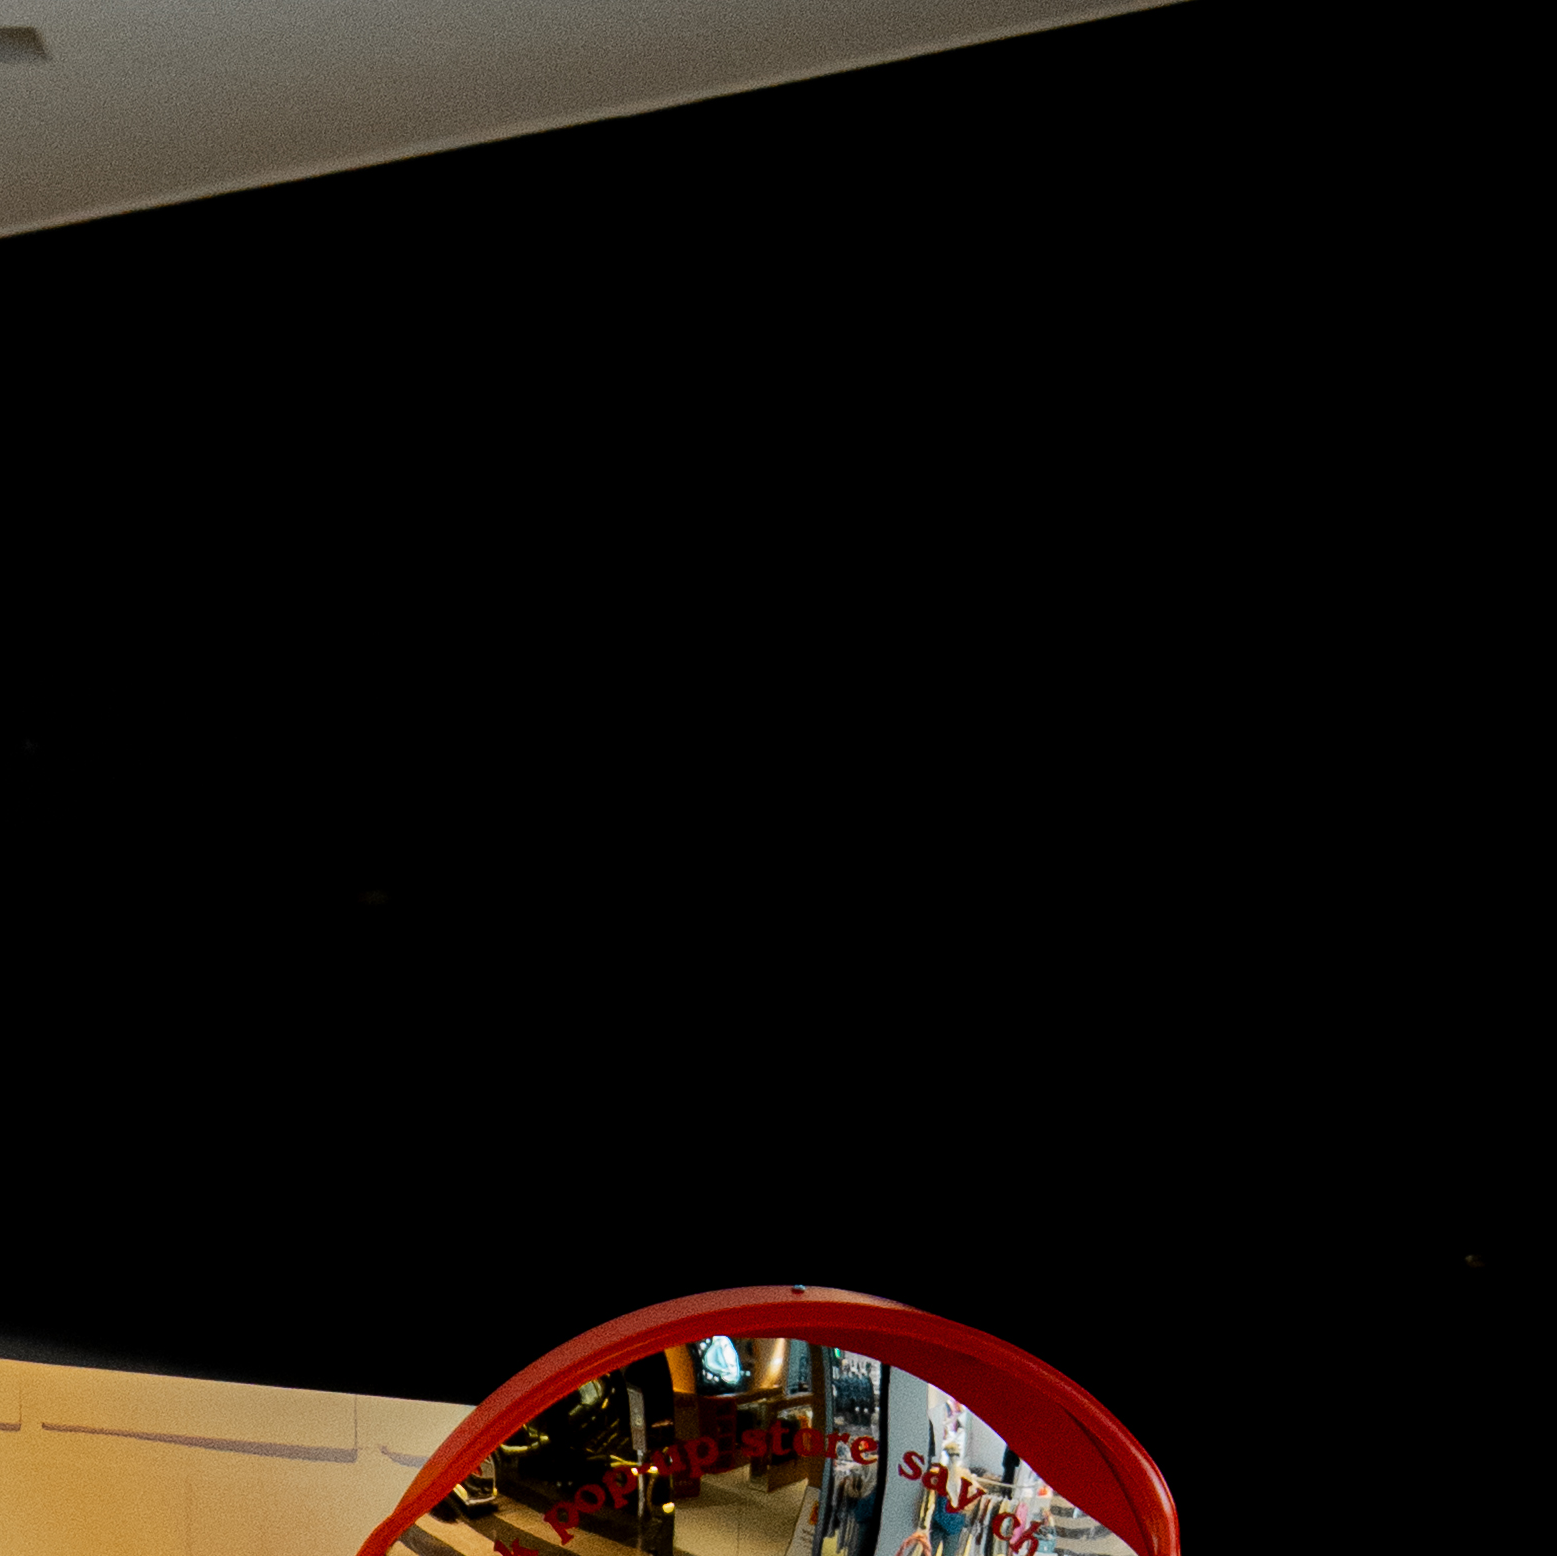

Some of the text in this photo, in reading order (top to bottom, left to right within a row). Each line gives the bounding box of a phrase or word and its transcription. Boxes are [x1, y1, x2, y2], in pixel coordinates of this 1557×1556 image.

[543, 1436, 720, 1546] pop-up
[741, 1419, 879, 1465] store
[898, 1450, 987, 1514] say
